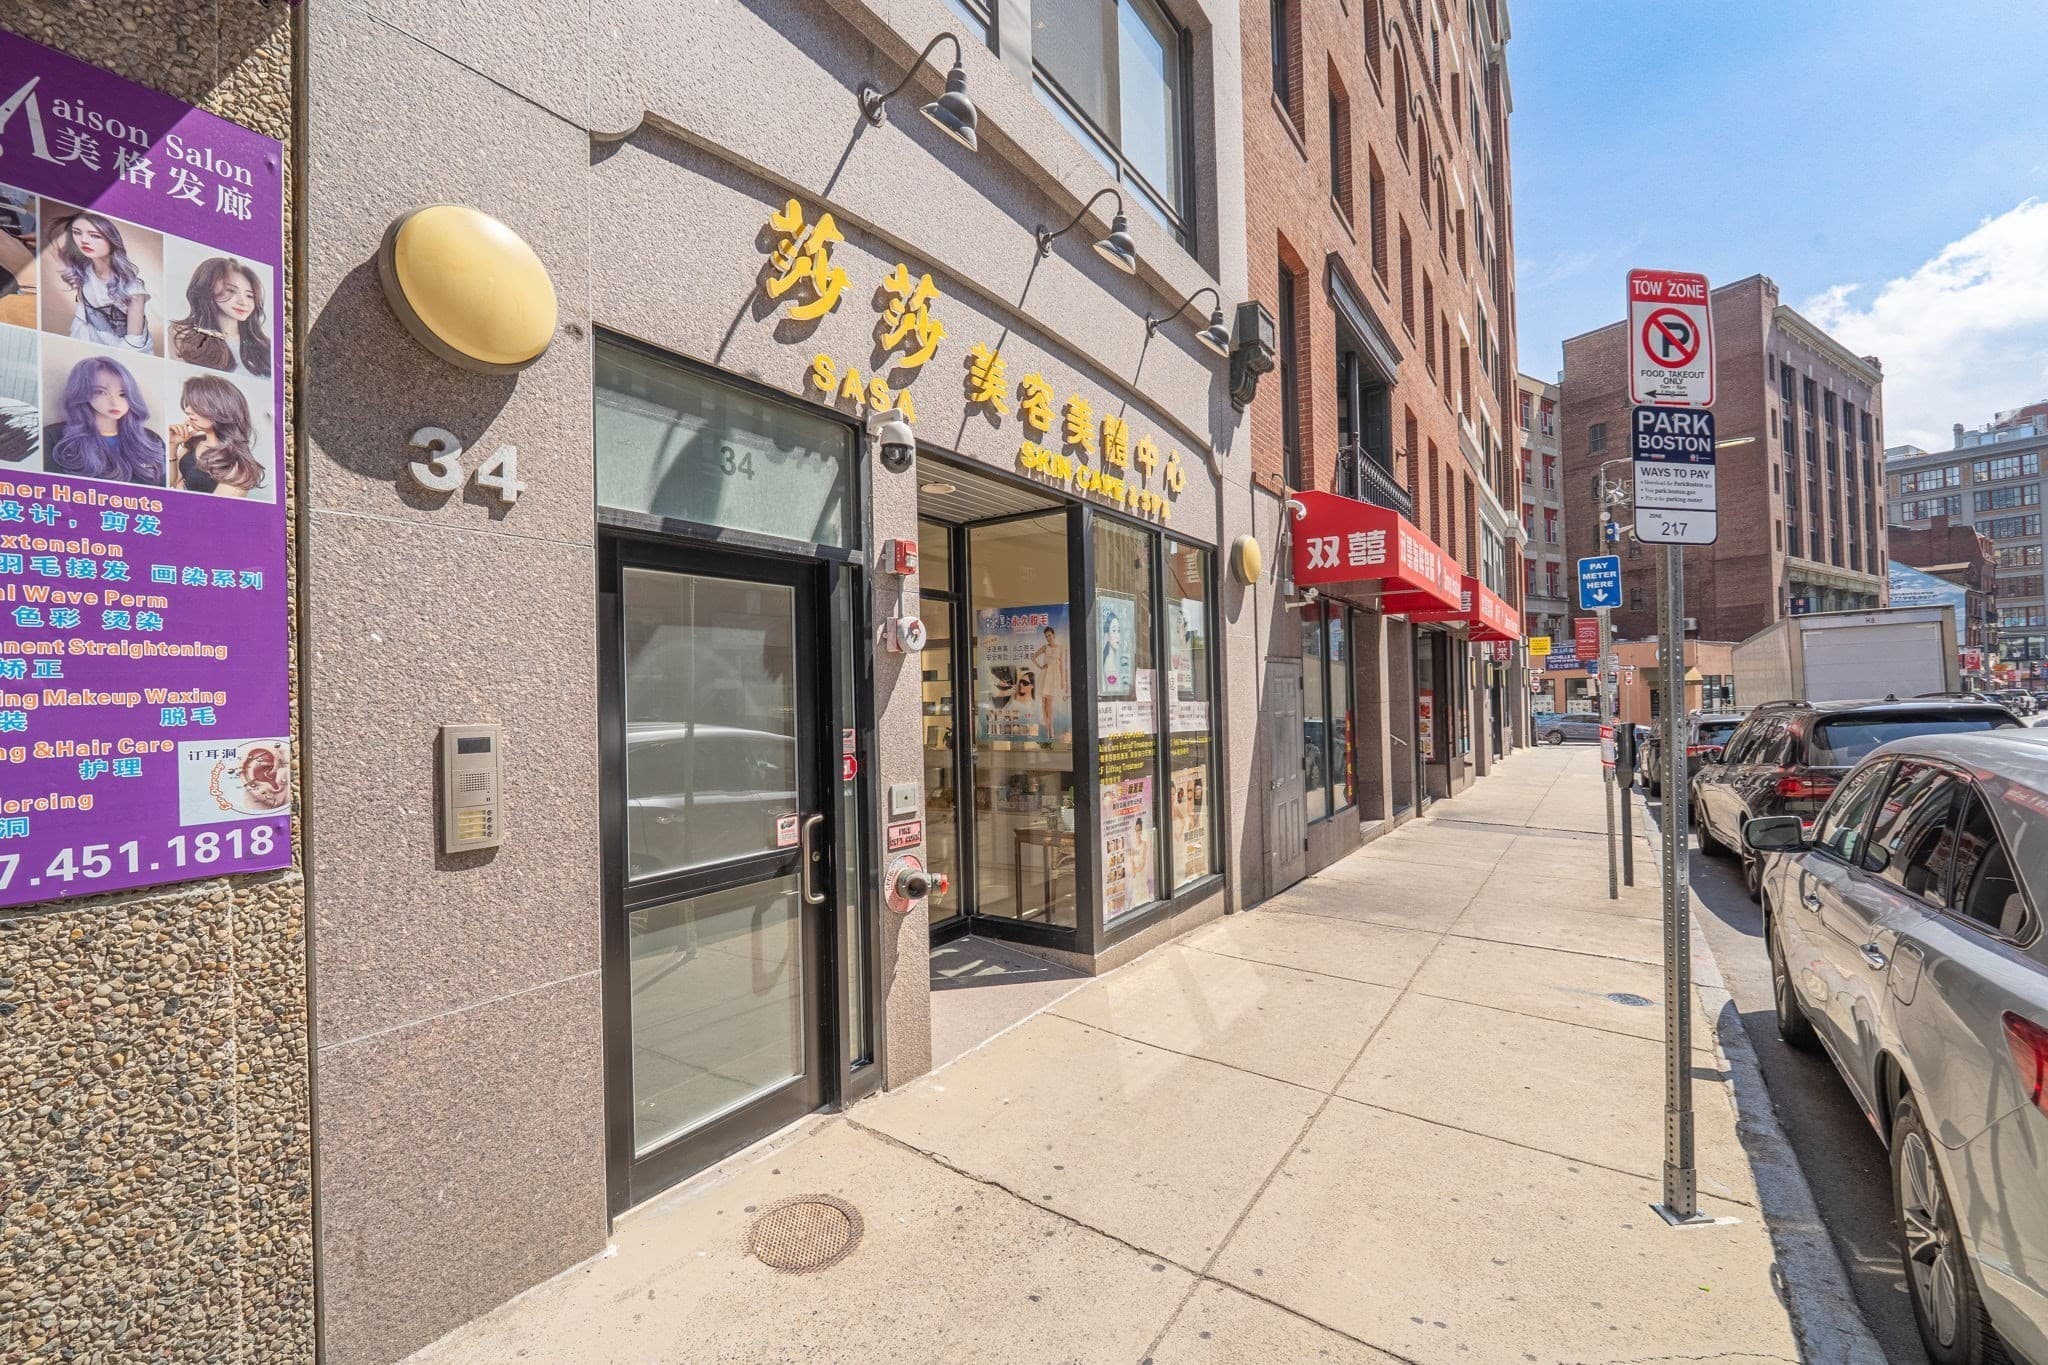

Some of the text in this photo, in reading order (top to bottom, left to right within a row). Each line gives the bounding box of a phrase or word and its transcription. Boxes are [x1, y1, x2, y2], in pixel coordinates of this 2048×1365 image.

[166, 134, 253, 187] Salon
[55, 127, 253, 221] 美格发廊
[1632, 279, 1705, 299] TOW ZONE
[1640, 369, 1705, 379] FOOD TAKEOUT
[1663, 377, 1684, 385] ONLY
[813, 353, 917, 424] SASA
[1638, 411, 1711, 436] PARK
[1638, 434, 1711, 453] BOSTON
[408, 426, 526, 502] 34
[719, 446, 755, 480] 34
[1020, 441, 1072, 480] SKIN
[1076, 464, 1125, 502] CARE
[1640, 467, 1711, 479] WAYS TO PAY
[52, 484, 163, 513] Haircuts
[100, 510, 162, 536] 剪发
[1661, 521, 1688, 536] 217
[0, 553, 264, 591] 羽毛接发 画染系列
[1582, 571, 1617, 580] METER
[1589, 562, 1609, 570] PAY
[1586, 580, 1614, 589] HERE
[23, 584, 98, 605] Wave
[104, 589, 168, 608] Perm
[11, 606, 164, 632] 色彩 烫染
[0, 638, 228, 660] nent Straightening
[0, 658, 64, 680] 矫正
[43, 689, 141, 707] Makeup
[144, 688, 227, 705] Waxing
[160, 706, 216, 727] 脱毛
[117, 738, 174, 754] Care
[78, 757, 142, 780] 护理
[0, 825, 274, 890] 7.451.1818
